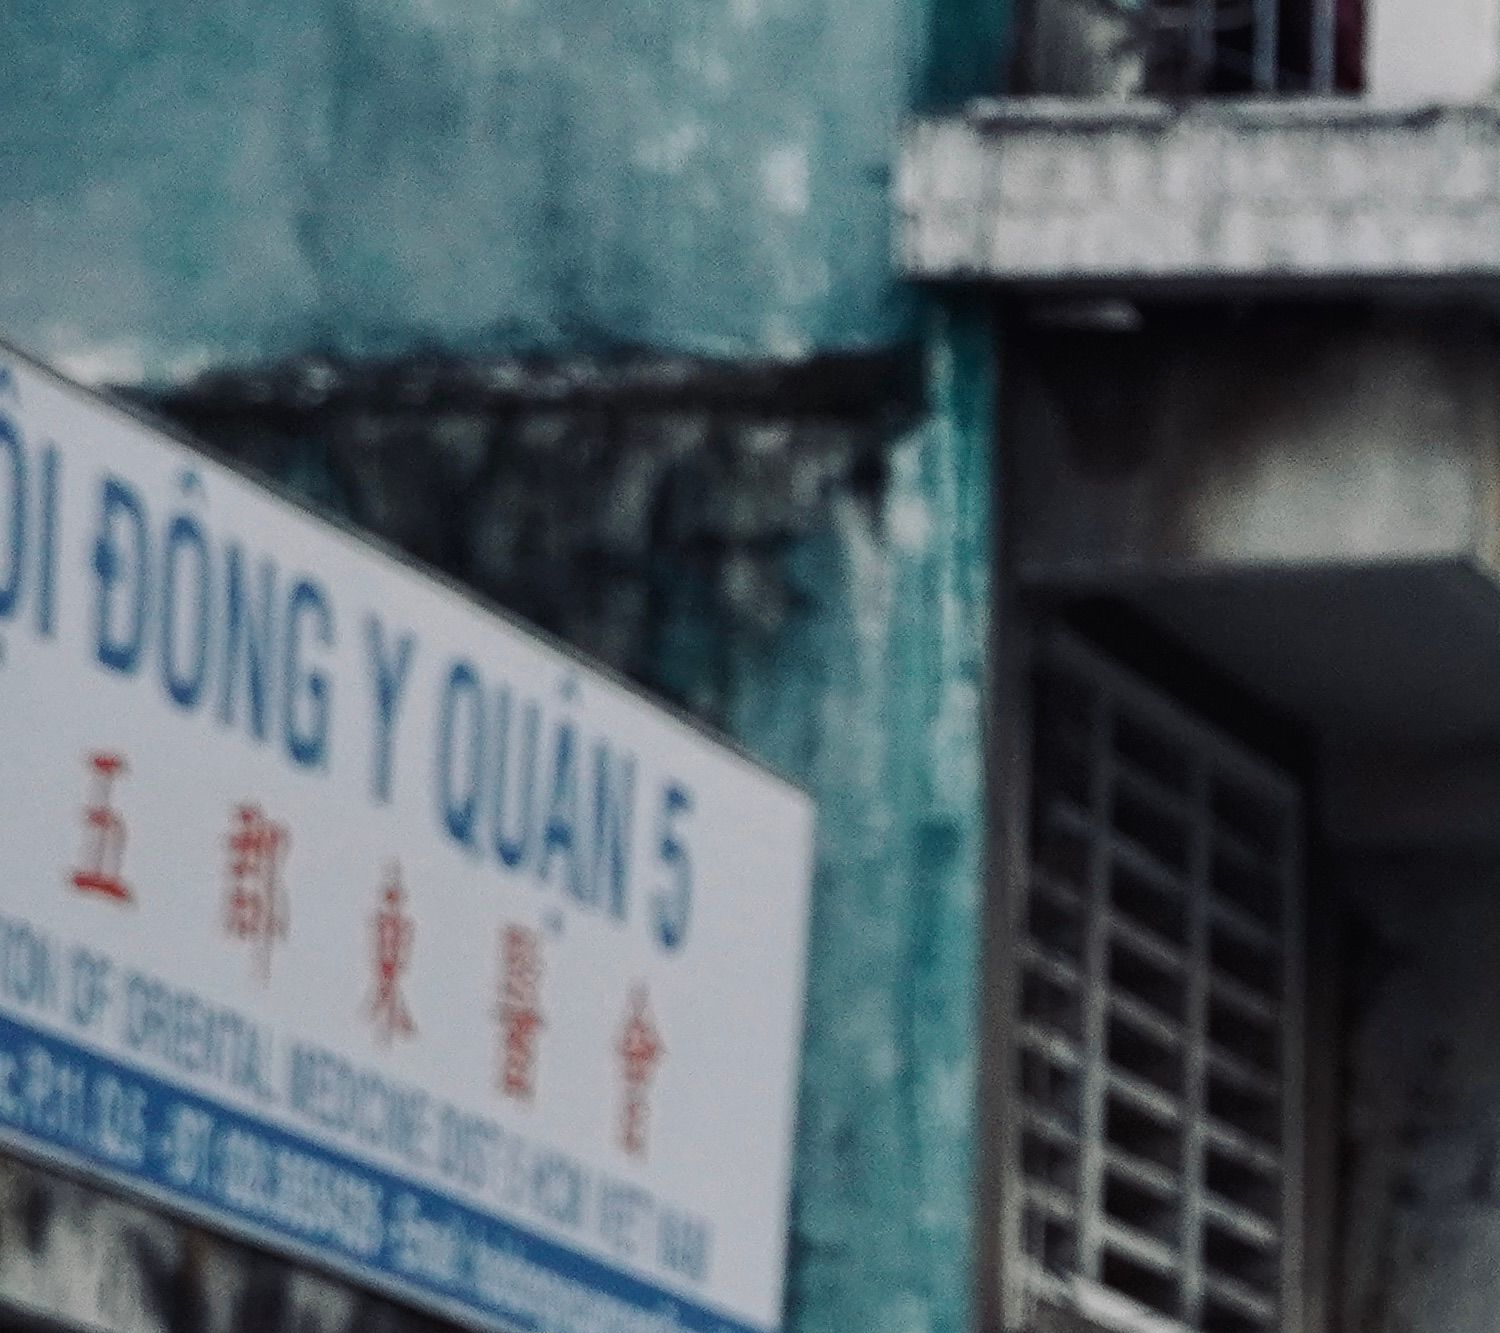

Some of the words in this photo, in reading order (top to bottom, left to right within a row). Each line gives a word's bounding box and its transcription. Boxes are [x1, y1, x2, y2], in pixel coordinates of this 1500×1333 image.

[93, 464, 336, 768] ĐÔNG
[363, 612, 417, 806] Y
[438, 660, 638, 938] QUẬN
[649, 778, 694, 952] 5
